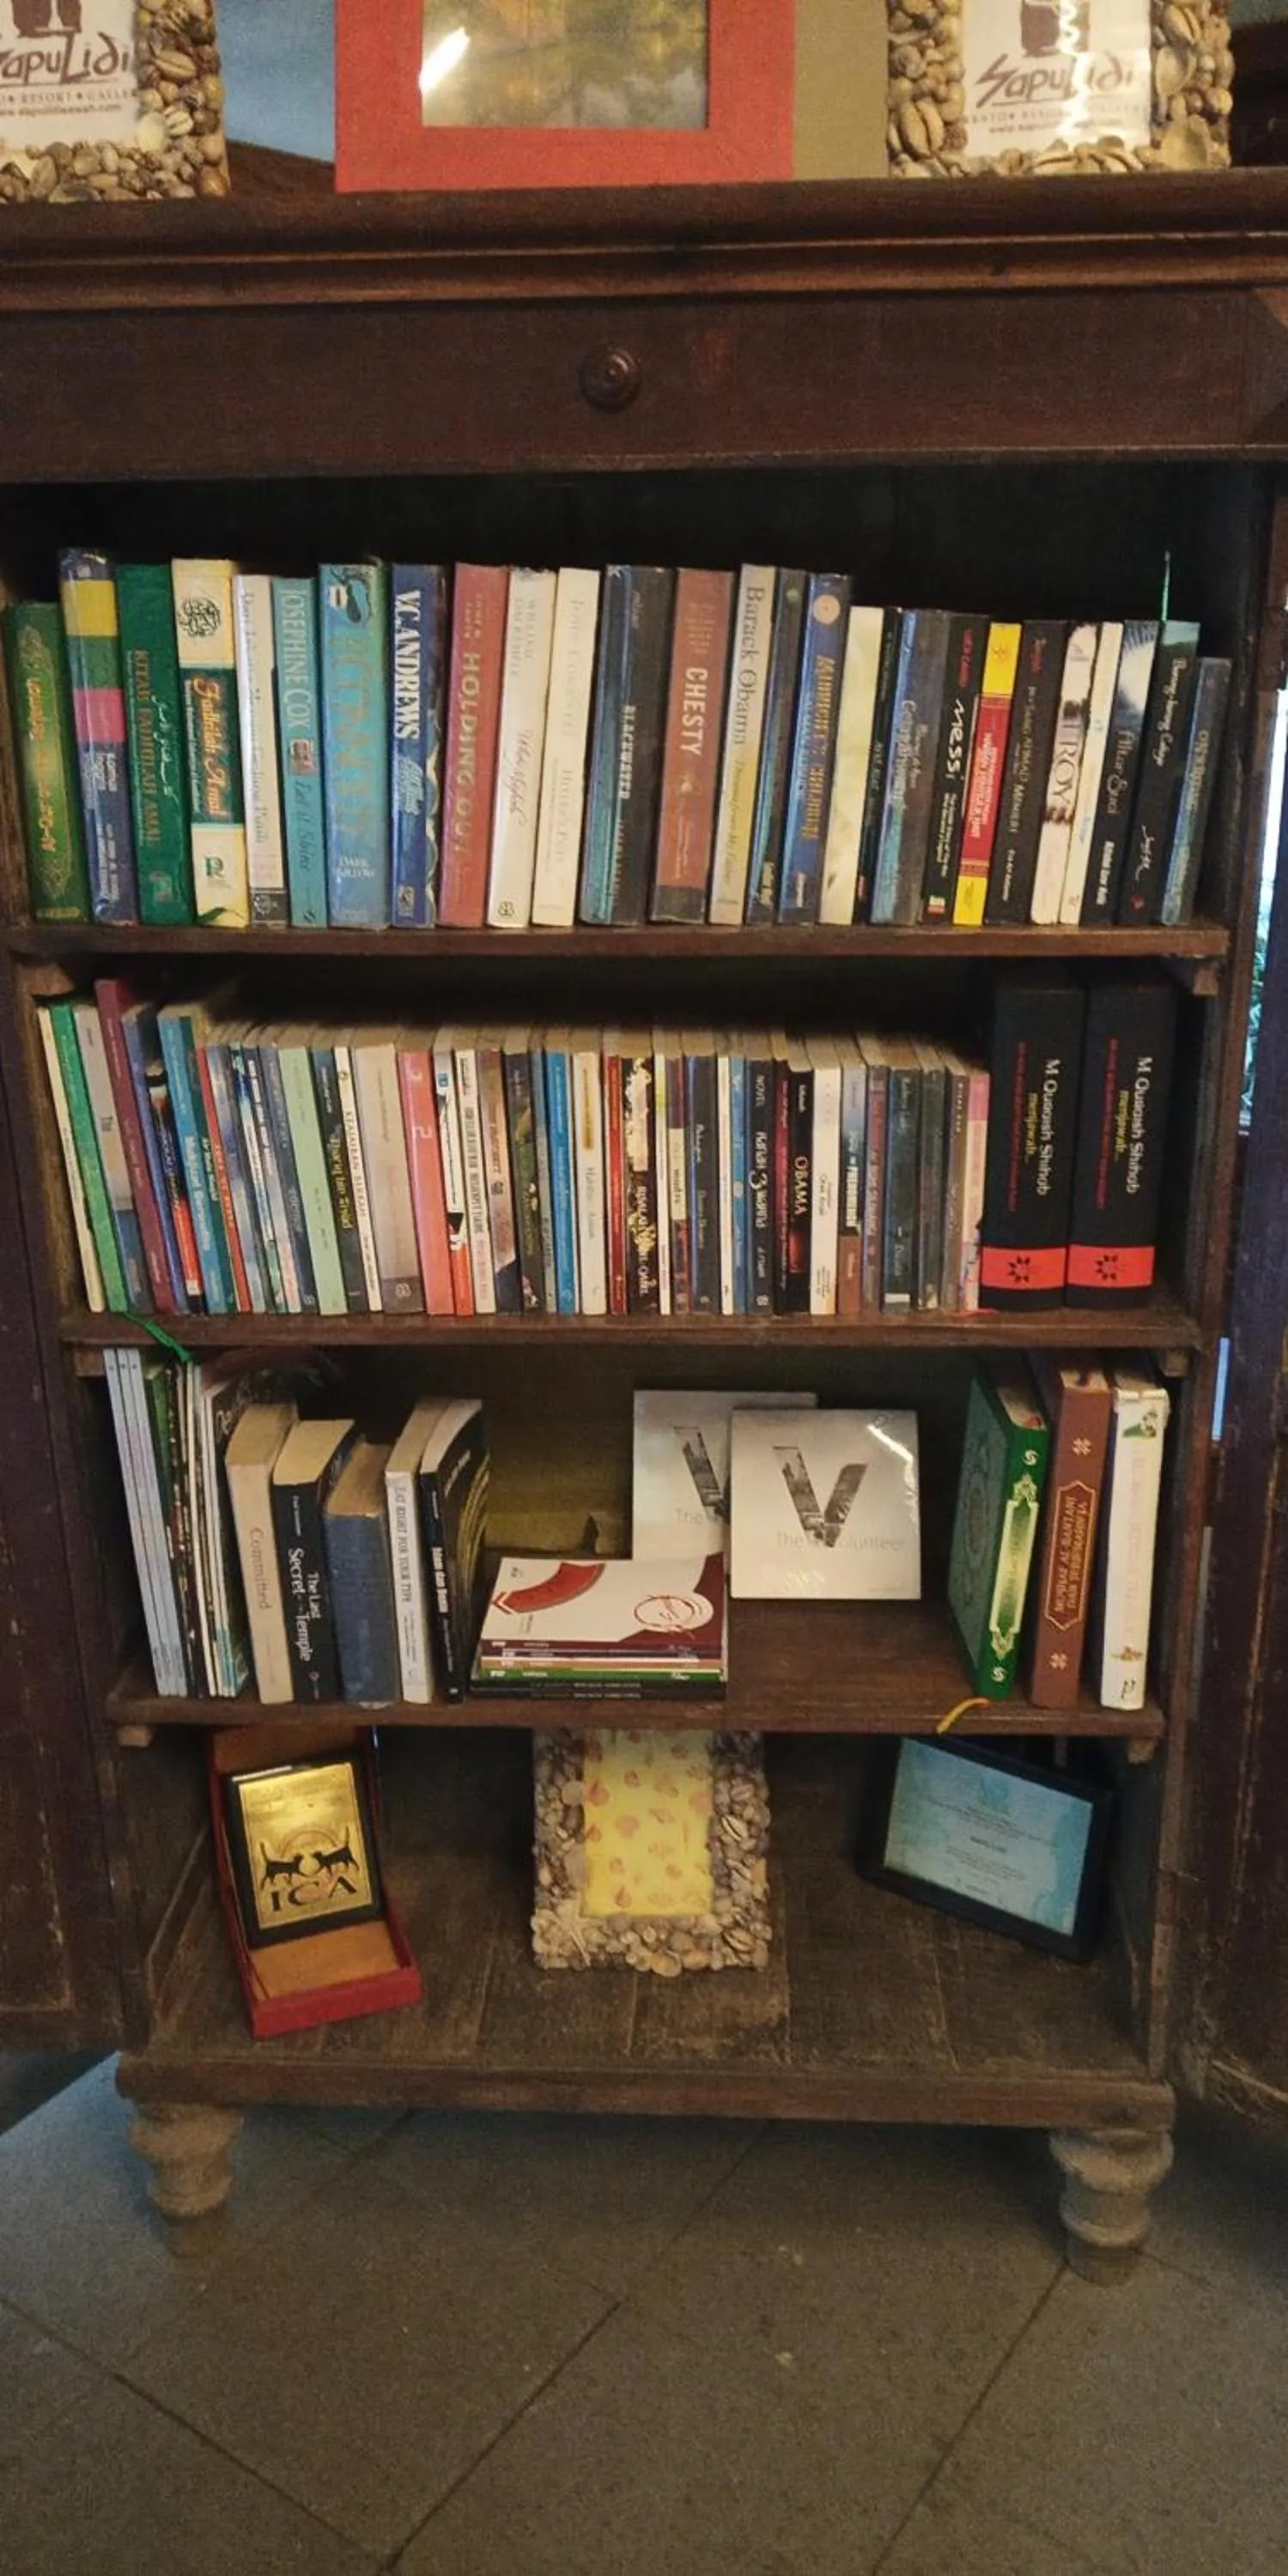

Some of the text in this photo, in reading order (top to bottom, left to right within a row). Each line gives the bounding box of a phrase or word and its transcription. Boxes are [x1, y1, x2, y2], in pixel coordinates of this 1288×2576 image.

[0, 31, 130, 84] apuLidi
[133, 650, 151, 701] KITAB
[279, 589, 311, 729] JOSEPHINE COX
[732, 586, 765, 746] Barack Obama
[454, 652, 479, 785] HOLDING
[679, 666, 708, 756] CHESTY
[191, 677, 228, 816] Fadhilah Amal
[618, 705, 635, 799] BLACKWATER
[1050, 721, 1084, 806] TROY
[452, 796, 471, 854] OUT
[747, 1170, 768, 1191] 3
[793, 1156, 808, 1216] OBAMA
[1035, 1145, 1052, 1196] Shihab
[1124, 1142, 1143, 1194] Shihab
[247, 1528, 272, 1610] Committed
[307, 1572, 320, 1619] The Last
[399, 1583, 411, 1603] TYPE
[287, 1547, 312, 1662] Secret Temple
[270, 1875, 357, 1912] ICA
